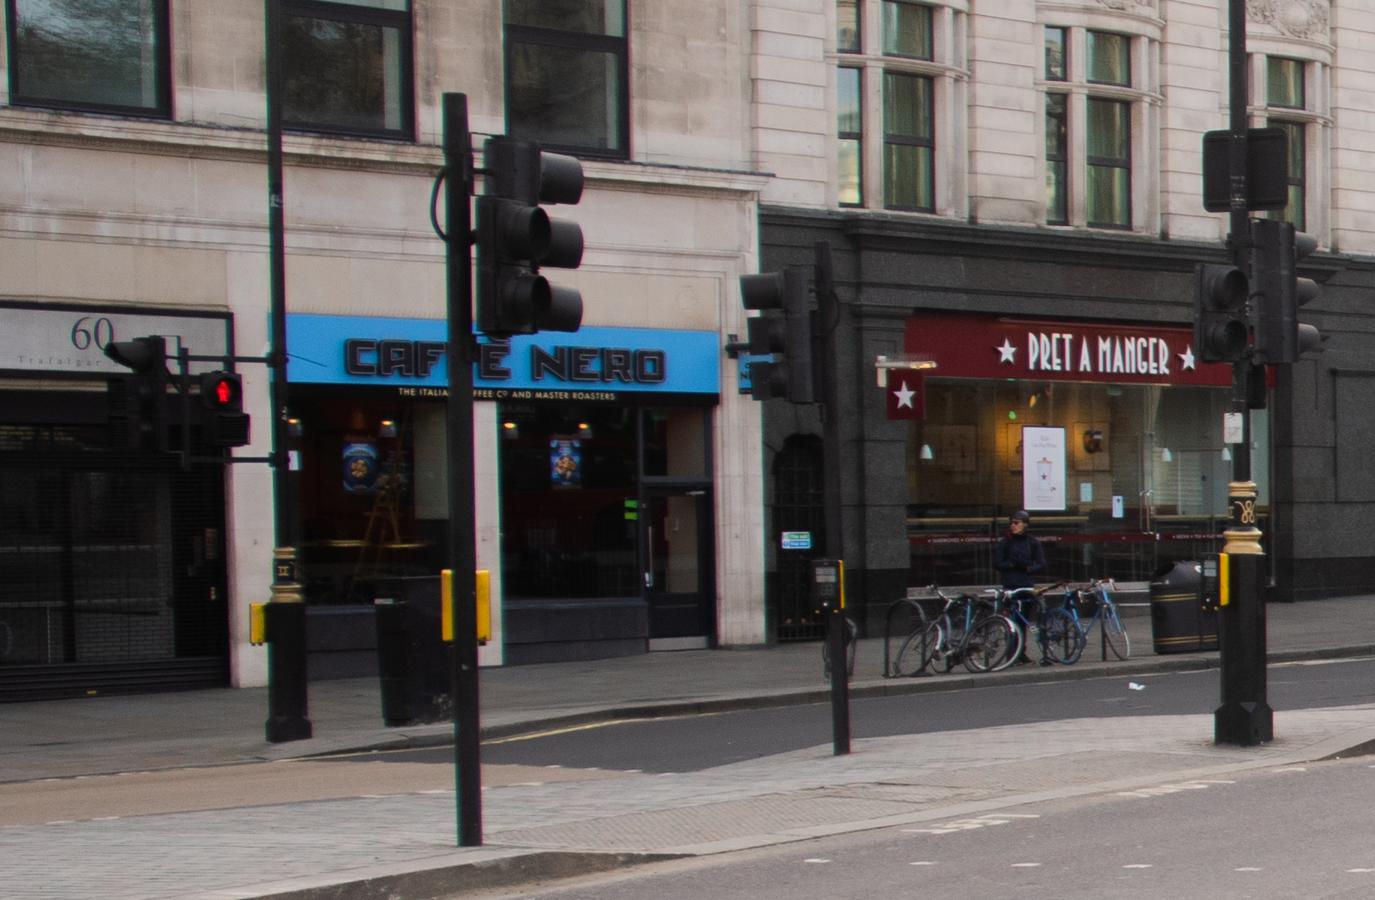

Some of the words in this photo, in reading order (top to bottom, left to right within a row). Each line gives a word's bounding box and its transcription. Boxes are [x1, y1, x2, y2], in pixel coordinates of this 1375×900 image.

[71, 316, 115, 351] 60
[17, 354, 102, 369] Trafalgar
[531, 344, 666, 384] NERO
[1028, 332, 1073, 372] PRET
[1079, 335, 1092, 372] A
[1098, 335, 1170, 375] MANGER
[398, 388, 416, 396] THE
[419, 388, 449, 397] ITALIA
[512, 391, 532, 399] AND
[534, 392, 569, 400] MASTER
[572, 392, 616, 401] ROASTERS
